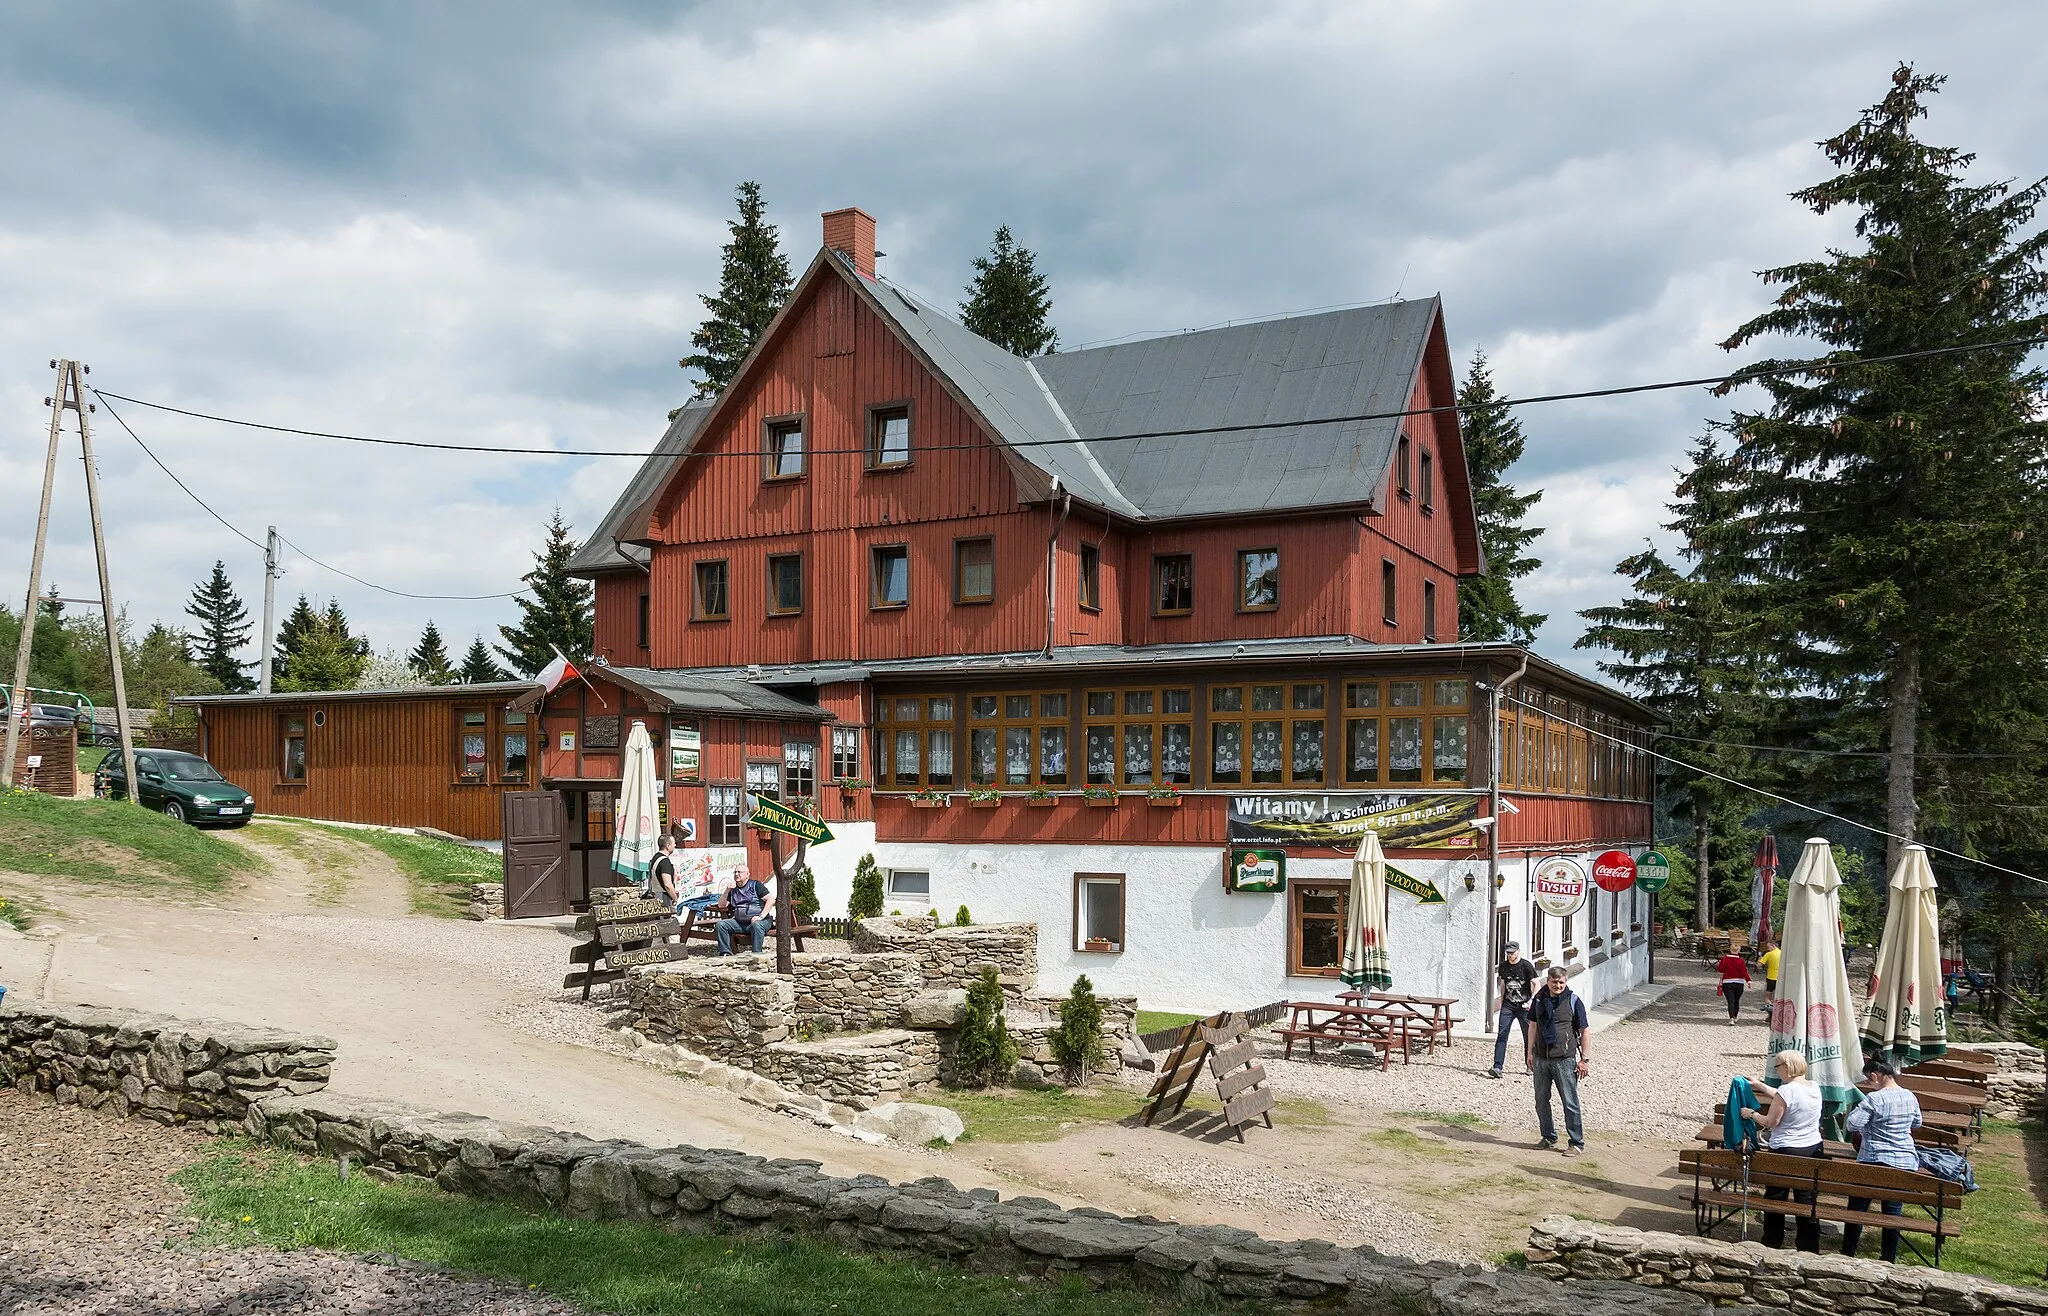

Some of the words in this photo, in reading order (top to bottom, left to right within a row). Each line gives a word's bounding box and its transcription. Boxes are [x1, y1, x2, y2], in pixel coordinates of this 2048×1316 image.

[1234, 797, 1316, 820] Witamy
[1331, 813, 1340, 822] w
[1343, 798, 1407, 819] Schronisku
[1377, 815, 1398, 828] 875
[1401, 812, 1411, 822] m
[1414, 804, 1450, 819] n.p.m.
[785, 816, 802, 831] POD
[1596, 865, 1633, 878] Coca-Cola
[1637, 866, 1665, 877] LECH
[1394, 875, 1411, 888] POD
[1540, 881, 1579, 895] TYSKIE
[1808, 1045, 1841, 1062] ilsner
